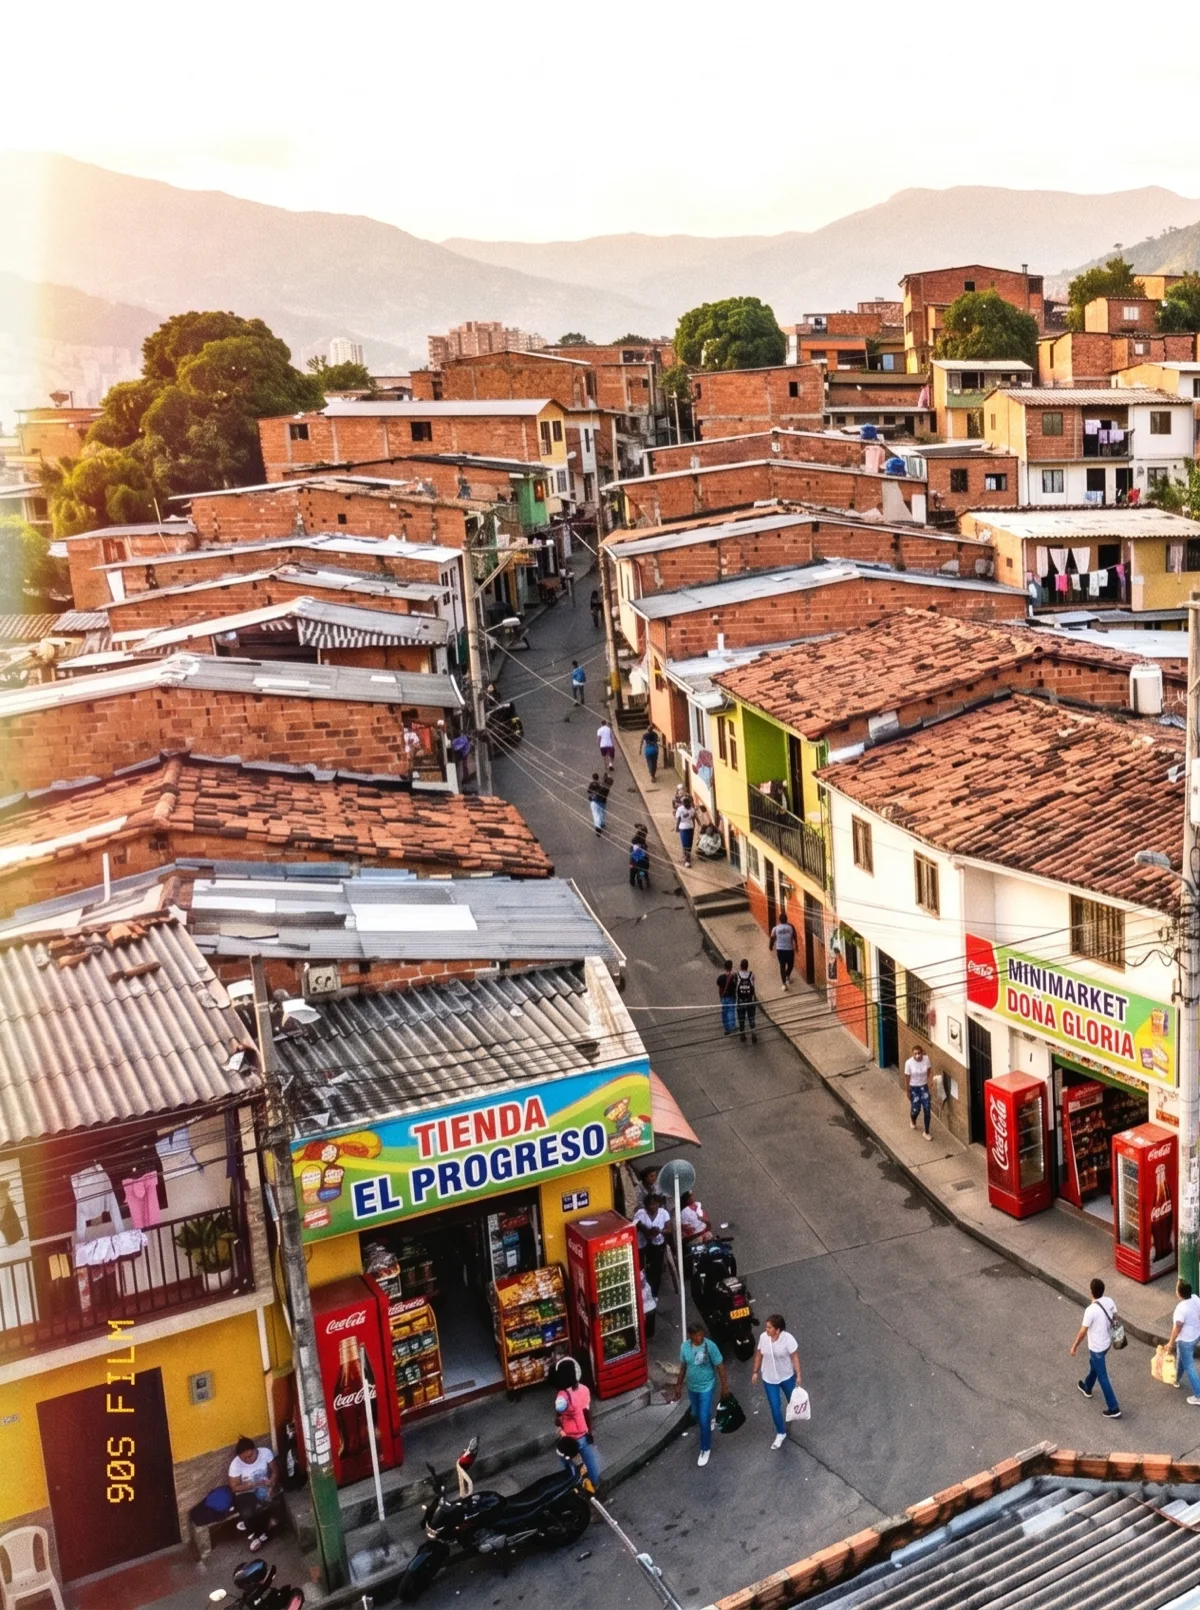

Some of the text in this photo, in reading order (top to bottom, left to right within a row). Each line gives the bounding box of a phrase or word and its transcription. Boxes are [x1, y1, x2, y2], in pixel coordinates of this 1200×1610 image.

[1007, 987, 1135, 1060] DOÑA GLORIA
[1008, 957, 1127, 1022] MINIMARKET
[413, 1096, 547, 1158] TIENDA
[353, 1124, 605, 1217] EL PROGRESO
